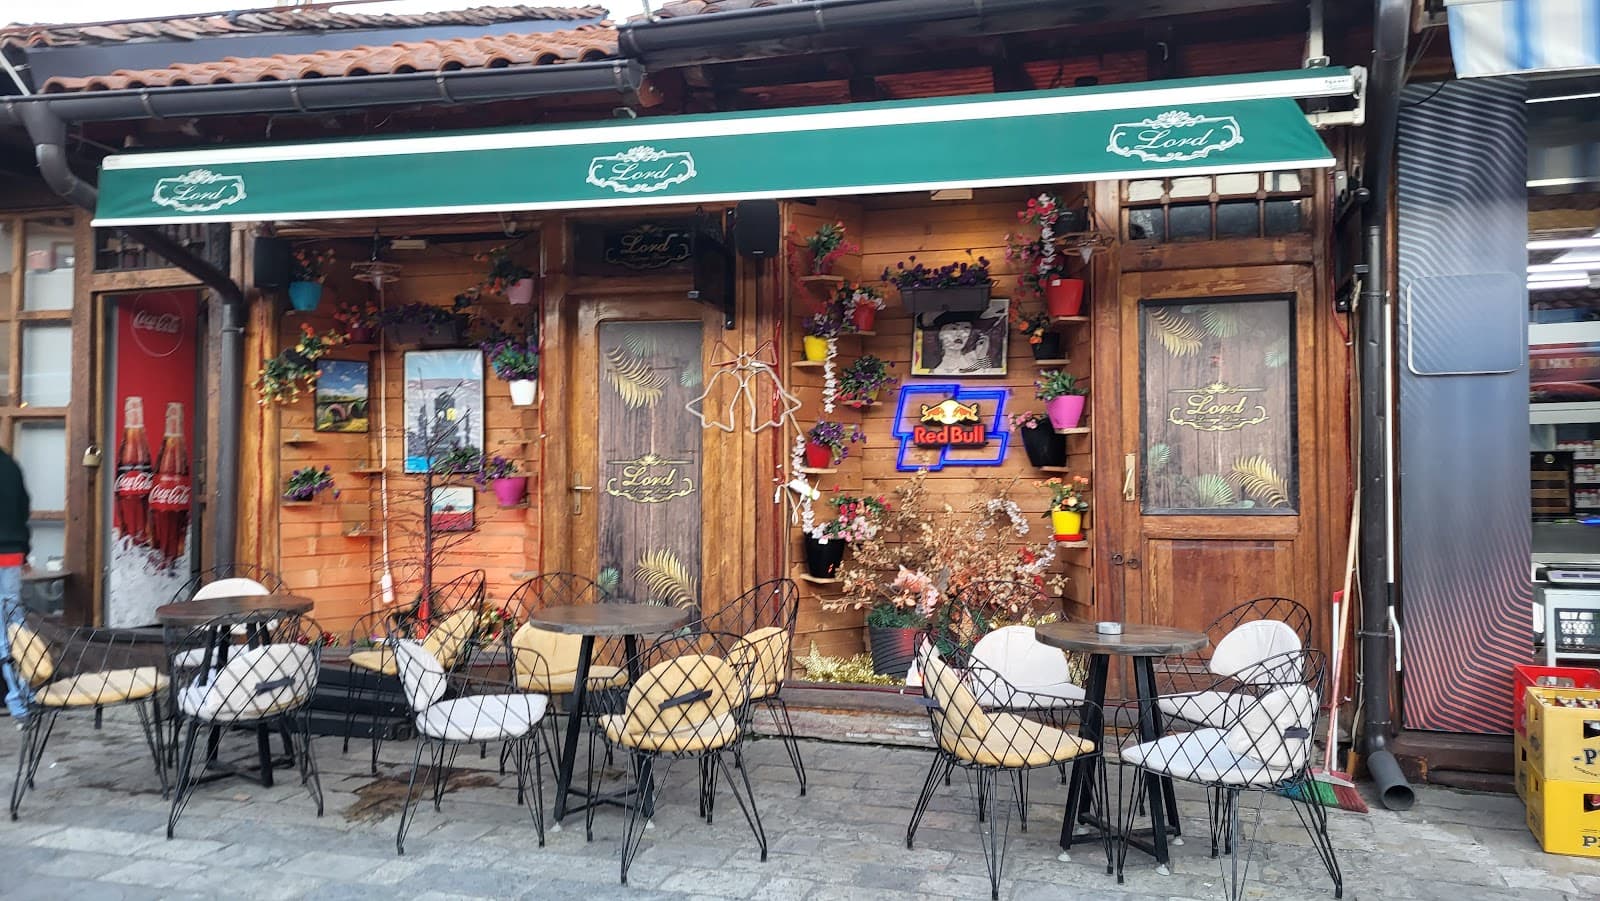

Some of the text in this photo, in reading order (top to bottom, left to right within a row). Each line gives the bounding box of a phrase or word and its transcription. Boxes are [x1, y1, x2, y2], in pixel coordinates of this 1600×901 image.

[1134, 128, 1215, 150] Lord
[608, 162, 675, 181] Lord
[170, 184, 228, 201] Lord
[620, 233, 679, 254] Lord
[1186, 394, 1248, 415] Lord
[914, 425, 985, 444] Red Bull
[622, 465, 677, 487] Lord
